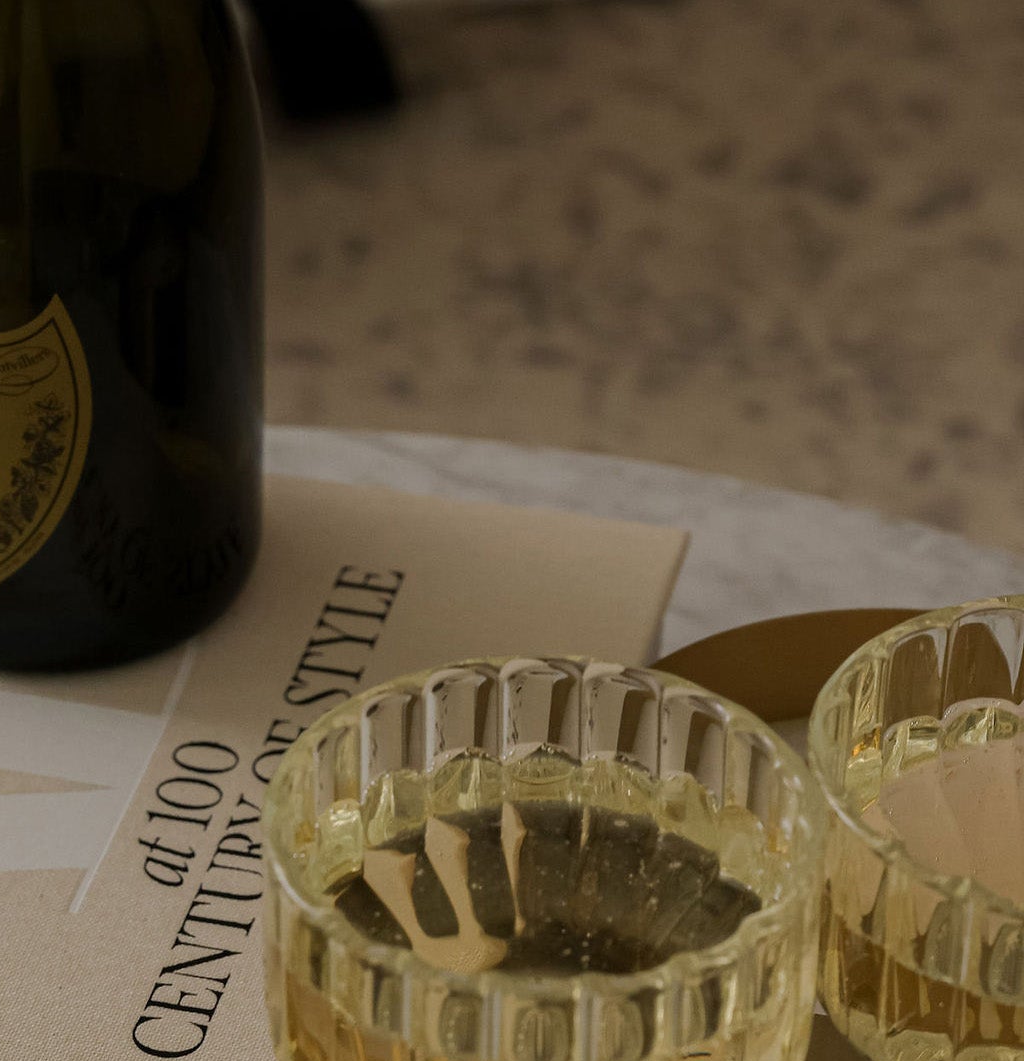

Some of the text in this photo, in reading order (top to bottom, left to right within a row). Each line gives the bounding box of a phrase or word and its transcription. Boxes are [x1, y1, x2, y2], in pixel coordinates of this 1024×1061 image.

[283, 564, 406, 706] STYLE
[138, 740, 240, 888] at 100
